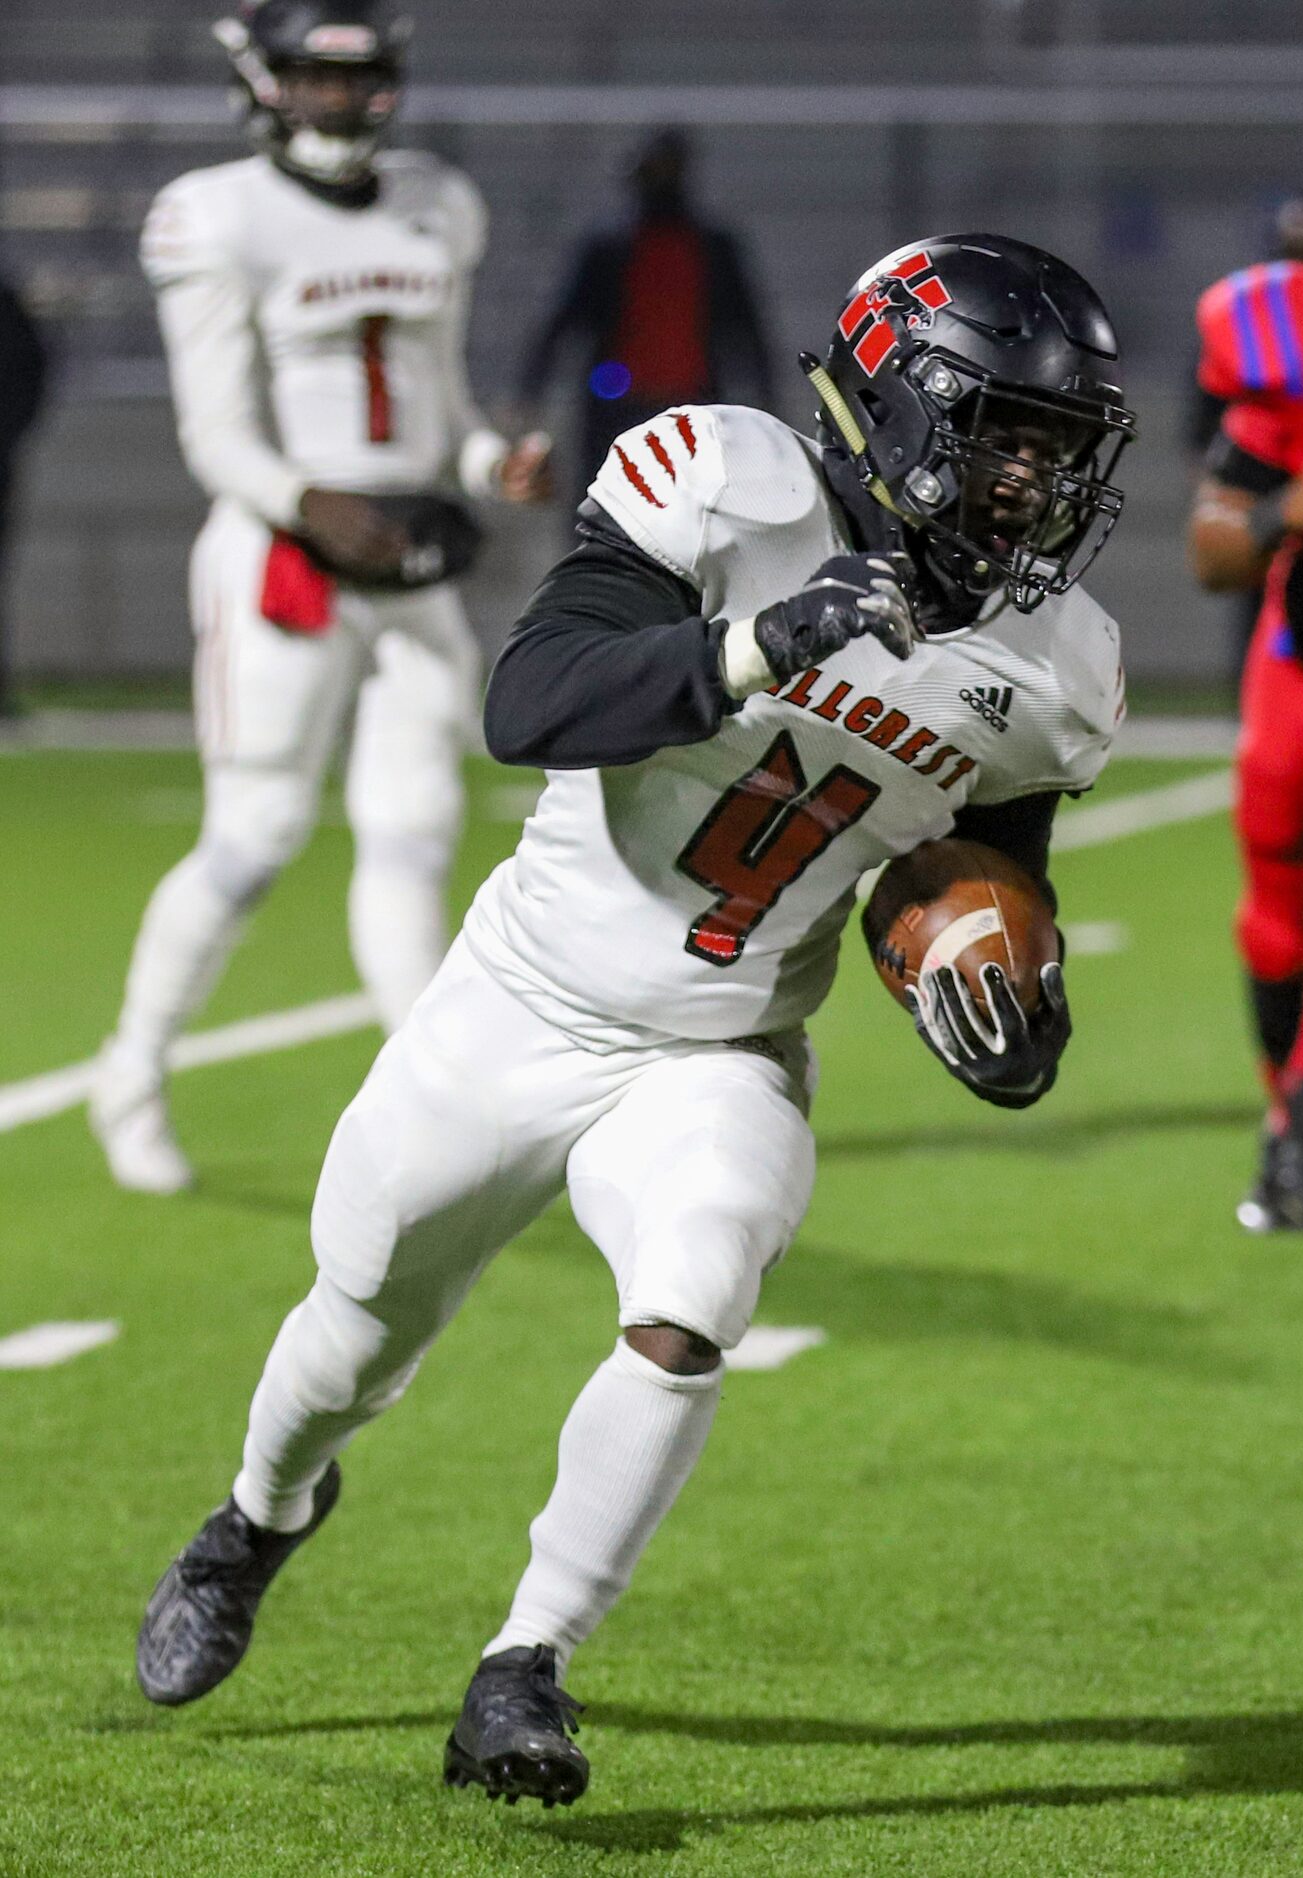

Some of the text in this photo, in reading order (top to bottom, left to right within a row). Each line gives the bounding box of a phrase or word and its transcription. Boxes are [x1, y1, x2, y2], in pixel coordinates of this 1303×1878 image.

[357, 313, 393, 443] 1
[764, 667, 976, 790] LLCREST
[958, 687, 1009, 732] adidas
[675, 729, 882, 967] 4
